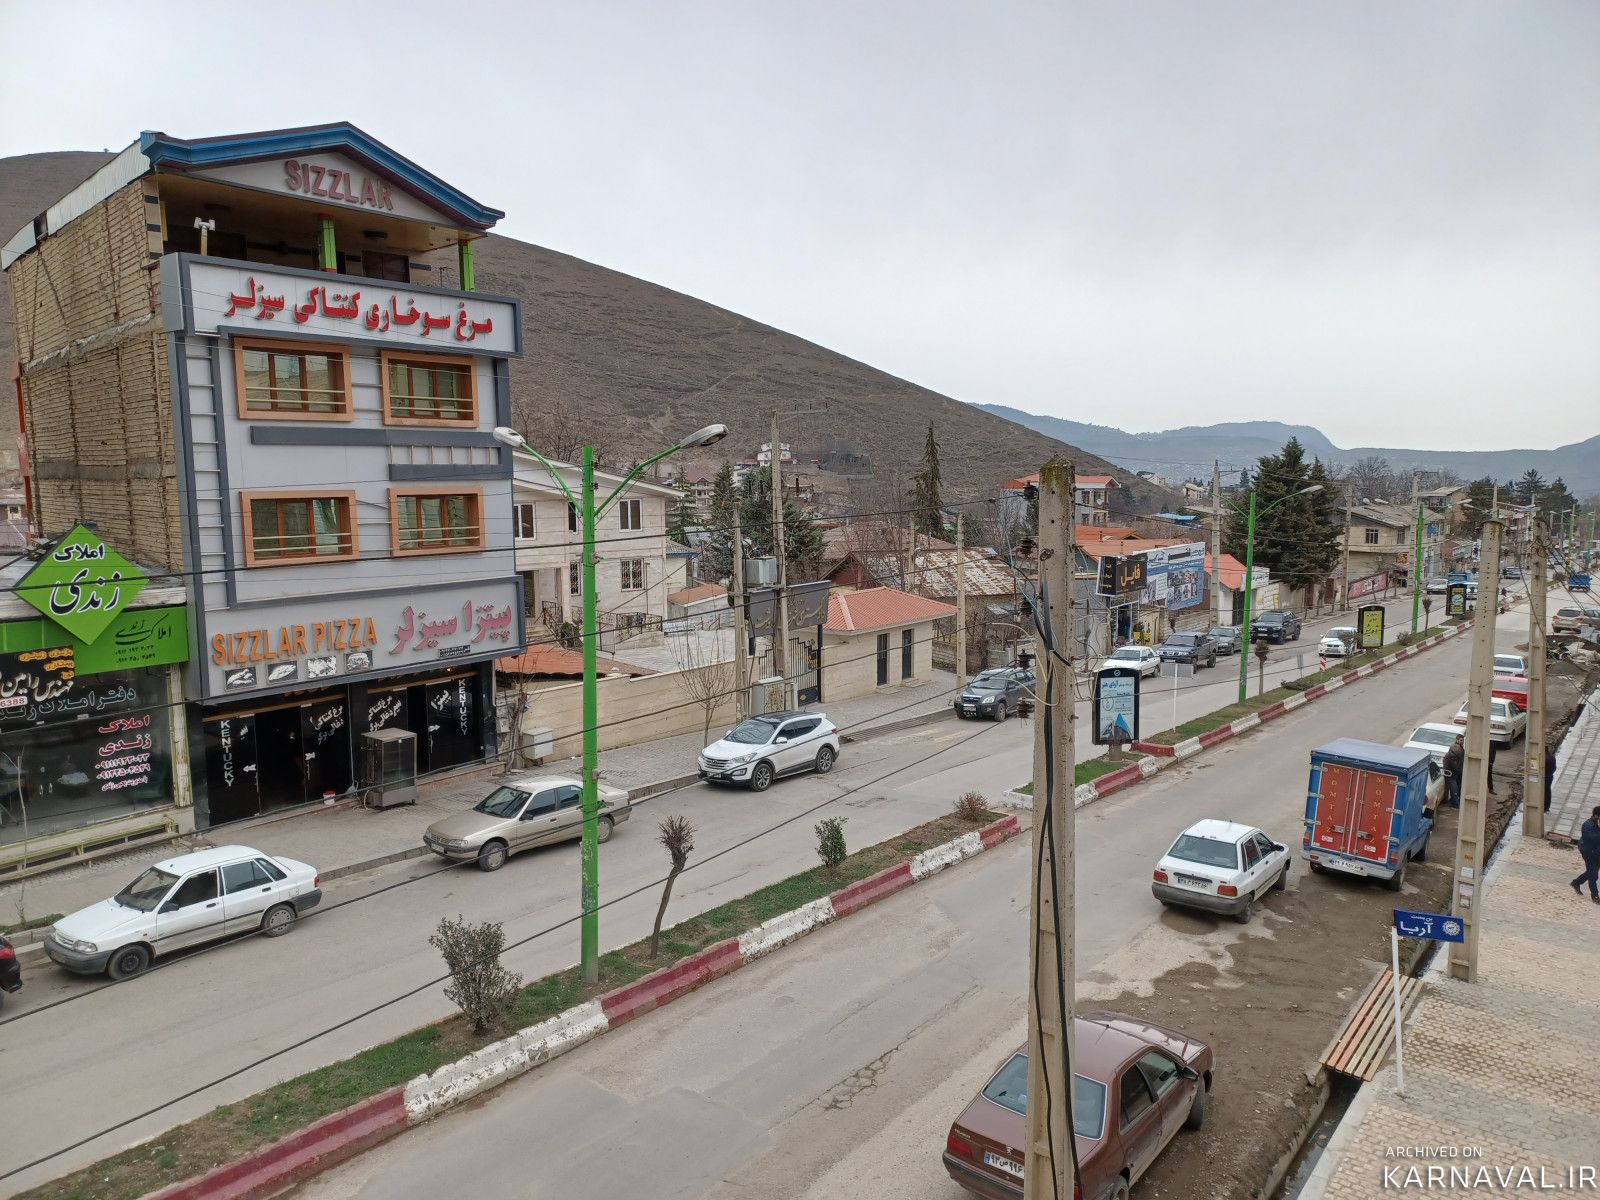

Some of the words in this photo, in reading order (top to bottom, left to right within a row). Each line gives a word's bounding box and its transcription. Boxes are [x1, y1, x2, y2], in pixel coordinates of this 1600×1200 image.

[284, 159, 394, 211] SIZZLAR
[224, 275, 285, 319] سیزلر
[294, 286, 362, 325] کنتاکی
[365, 295, 451, 337] سوخاری
[456, 302, 494, 342] مرغ
[54, 543, 105, 563] املاک
[50, 568, 122, 616] زندی
[1121, 564, 1141, 587] فایل
[211, 624, 308, 666] SIZZLAR
[312, 616, 379, 653] PIZZA
[390, 605, 458, 655] سیزلر
[463, 599, 513, 644] پیتزا
[97, 685, 137, 711] دفتر
[458, 679, 470, 736] KENTUCKY
[98, 715, 150, 733] املاک
[98, 734, 152, 757] زندی
[220, 720, 235, 787] KENTUCKY
[1326, 768, 1340, 833] MOMTAZ
[1369, 777, 1384, 844] MOMTAZ
[1400, 921, 1434, 936] آریا
